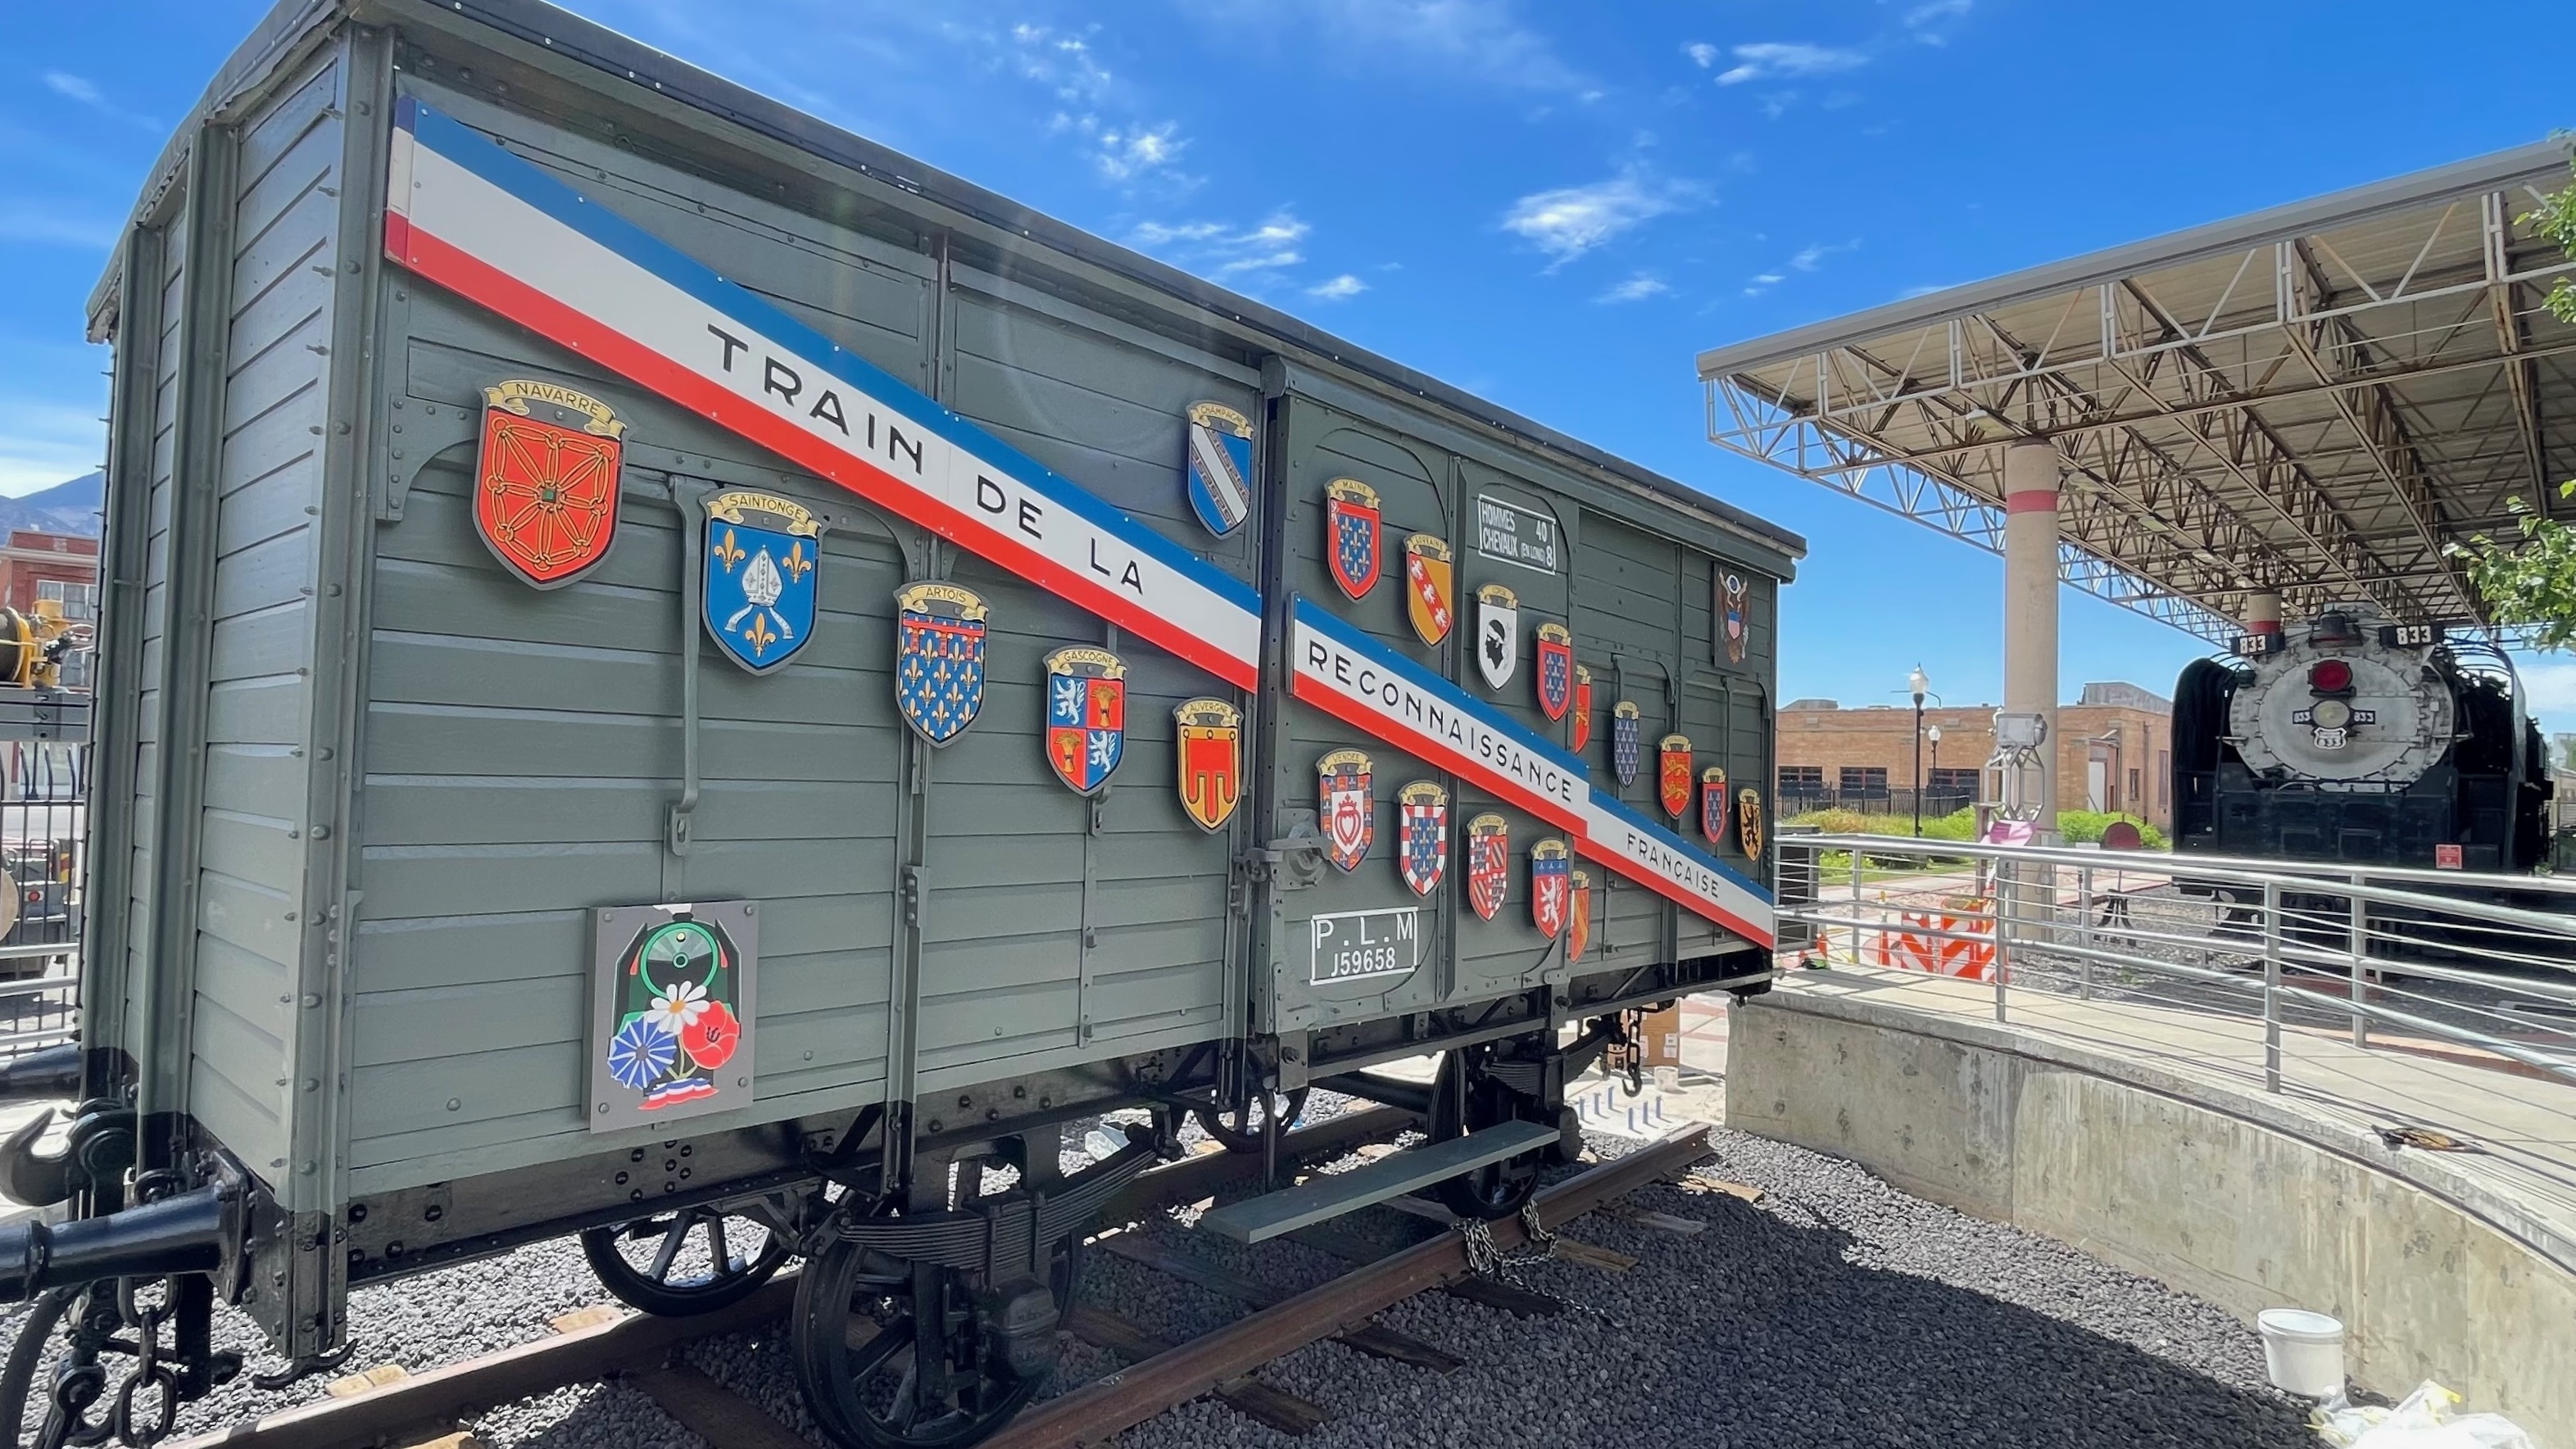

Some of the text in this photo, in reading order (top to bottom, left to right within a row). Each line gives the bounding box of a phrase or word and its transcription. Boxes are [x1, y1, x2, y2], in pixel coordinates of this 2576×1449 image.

[516, 383, 600, 415] NAVARRE
[708, 324, 1144, 595] TRAIN DE LA
[1343, 481, 1367, 493] MAINE
[729, 496, 804, 519] SAINTONGE
[1481, 501, 1548, 542] HOMMES 40
[1482, 527, 1518, 557] CHEVAUX
[1546, 545, 1553, 567] 8
[926, 587, 966, 603] ARTOIS
[2239, 635, 2266, 654] 833
[2396, 625, 2432, 645] 833
[1064, 650, 1113, 667] GASCOGNE
[1190, 702, 1229, 714] AUVERGNE
[2293, 710, 2311, 723] 833
[2353, 710, 2374, 722] 833
[1309, 640, 1571, 803] RECONNAISSANCE
[2318, 738, 2342, 747] 833
[1627, 832, 1719, 899] FRANÇAISE
[1331, 947, 1396, 977] J59658
